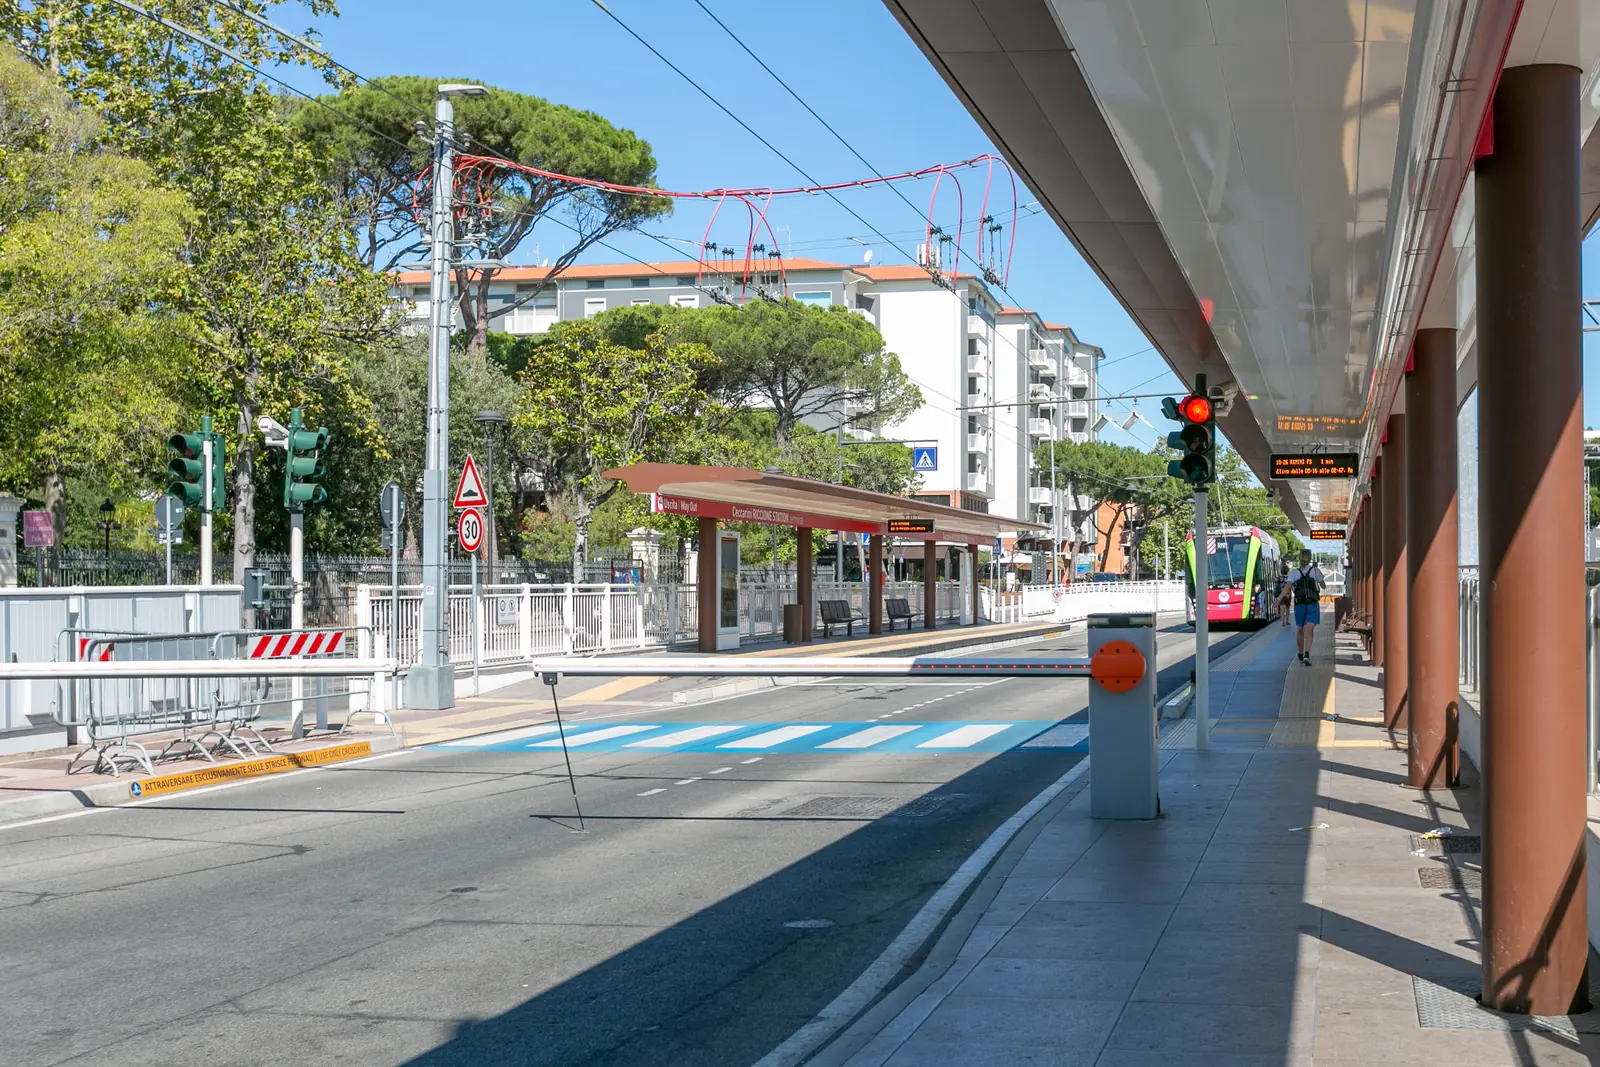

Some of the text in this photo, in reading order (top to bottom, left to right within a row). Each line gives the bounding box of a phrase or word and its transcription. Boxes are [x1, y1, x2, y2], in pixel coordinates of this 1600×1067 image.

[664, 498, 698, 513] Uscita Way Out
[732, 506, 752, 519] Ceccarini
[753, 509, 772, 521] RICCIONE
[773, 511, 789, 523] STATION
[464, 520, 478, 539] 30
[145, 775, 194, 792] ATTRAVERSARE
[196, 766, 247, 782] ESCLUSIVAMENTE
[248, 763, 264, 772] SULLE
[265, 759, 287, 770] STRISCE
[329, 749, 342, 758] ONLY
[342, 745, 370, 756] CROSSWALK
